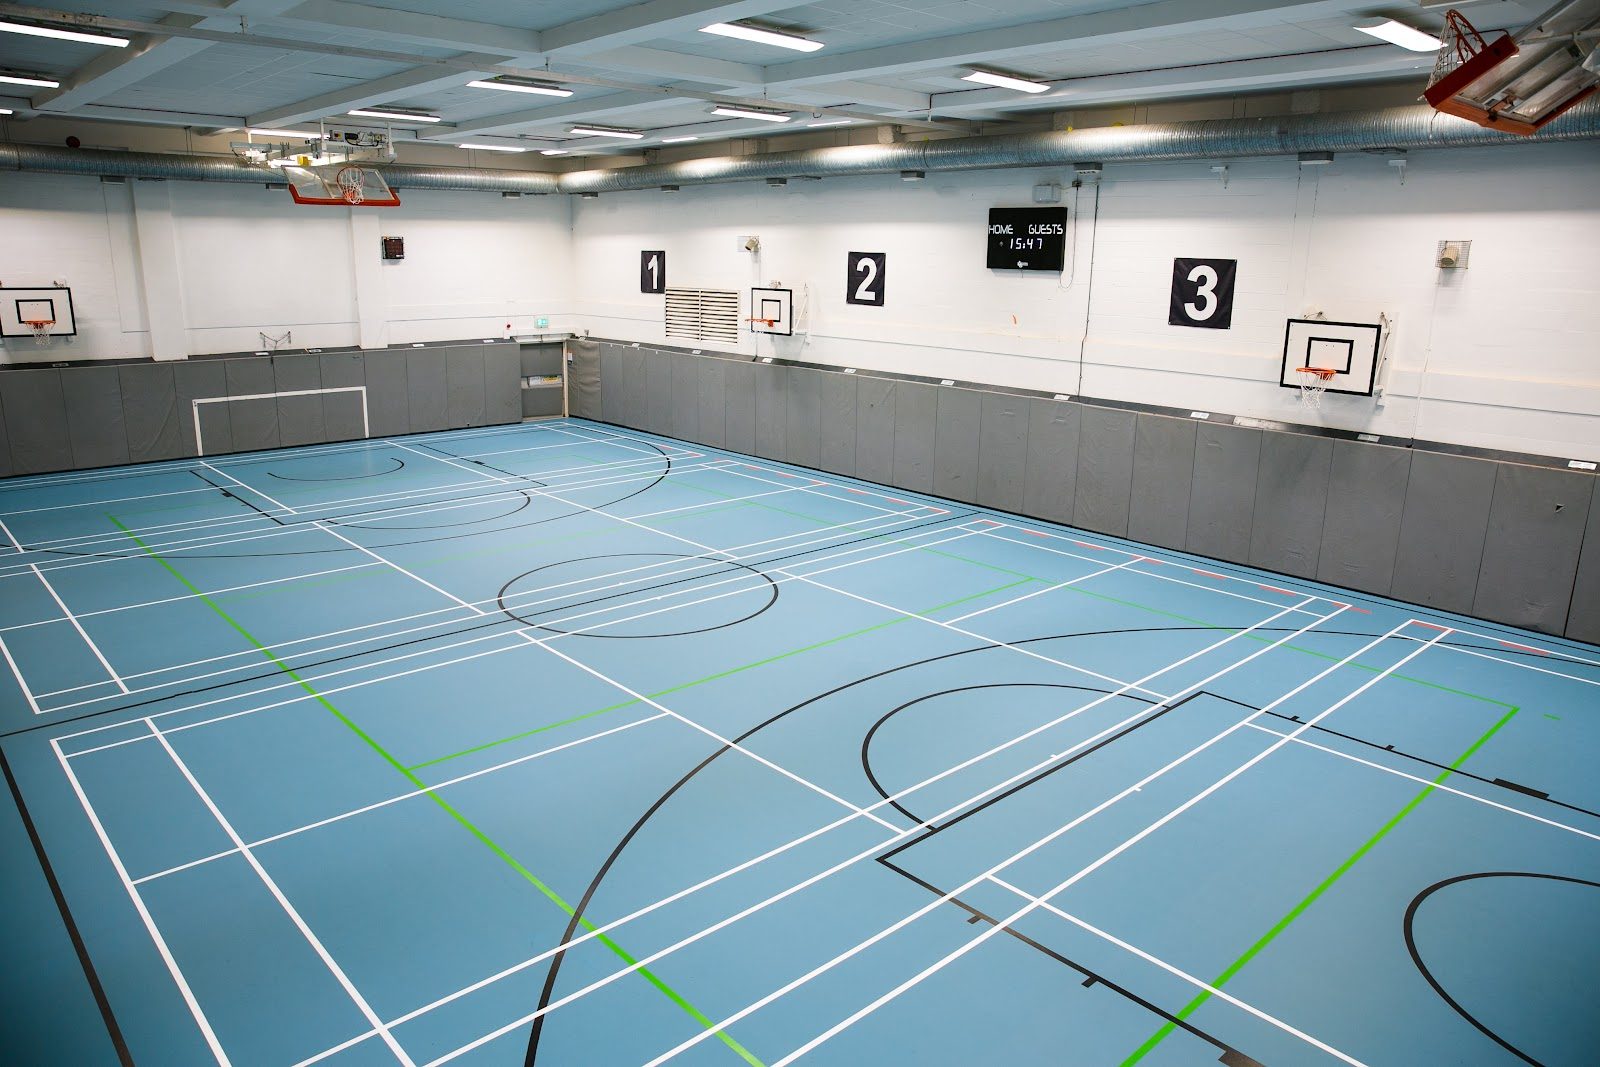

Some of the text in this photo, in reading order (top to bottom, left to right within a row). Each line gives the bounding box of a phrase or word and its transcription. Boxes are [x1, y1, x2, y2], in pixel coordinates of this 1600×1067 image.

[988, 223, 1063, 235] HOME GUESTS
[1010, 237, 1043, 250] 15:47
[647, 254, 658, 290] 1
[854, 257, 878, 301] 2
[1184, 264, 1219, 321] 3
